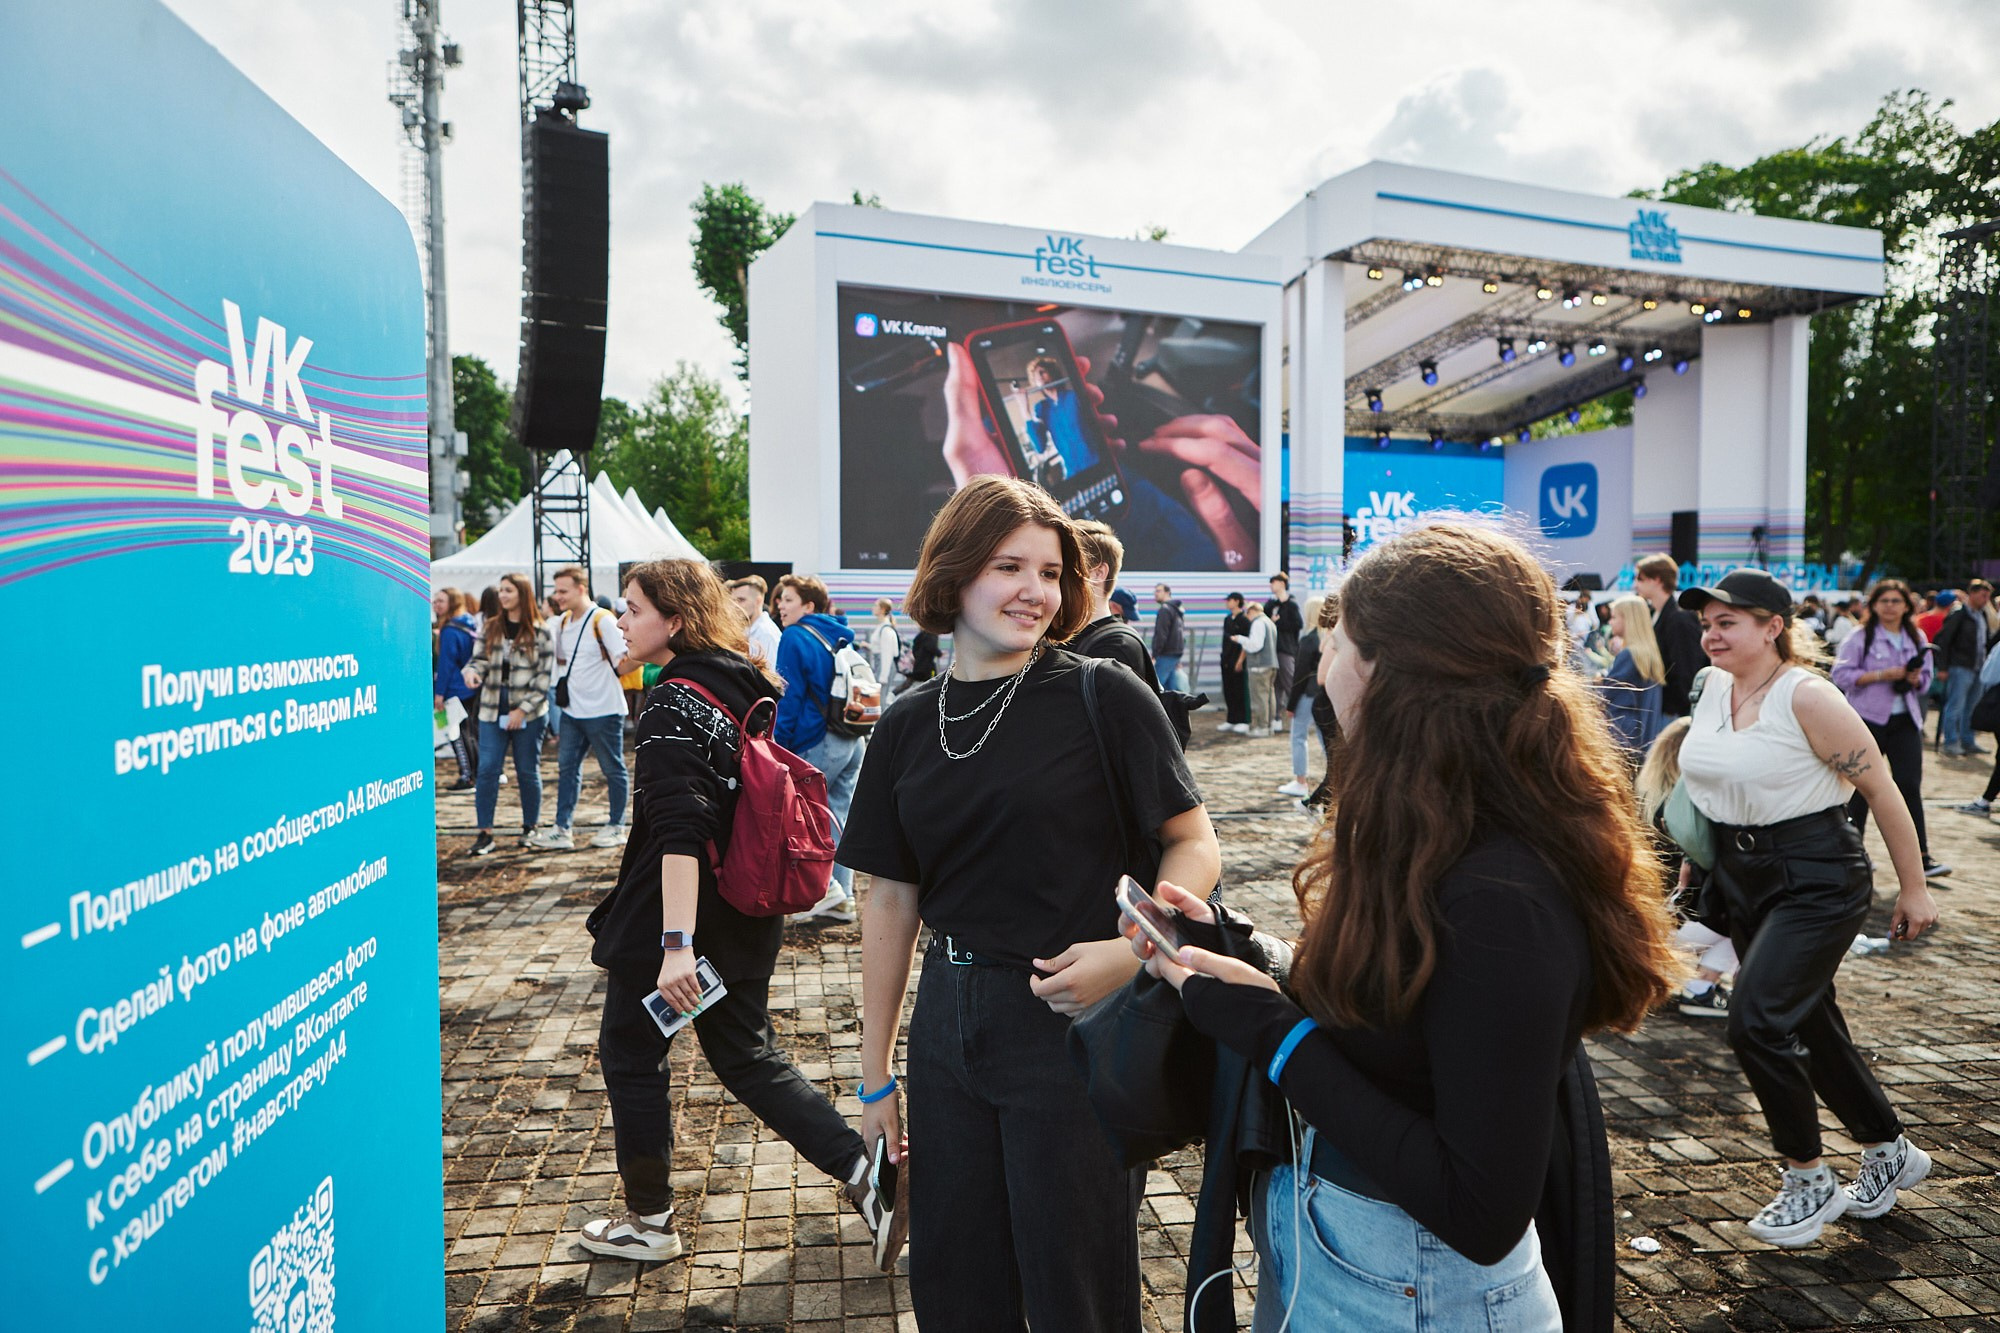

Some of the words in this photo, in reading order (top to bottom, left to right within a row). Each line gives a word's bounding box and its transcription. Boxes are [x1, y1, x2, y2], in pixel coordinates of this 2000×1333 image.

[1046, 235, 1085, 256] VK
[1637, 209, 1669, 230] VK
[1021, 276, 1112, 294] ИНФЛЮЕНСЕРЫ
[1035, 247, 1101, 278] fest
[881, 319, 902, 334] VK
[903, 321, 947, 338] Клипы
[222, 298, 315, 424] VK
[194, 358, 344, 520] fest
[1369, 491, 1416, 517] VK
[1549, 484, 1589, 518] VK
[229, 516, 314, 577] 2023
[1224, 550, 1243, 564] 12+
[142, 664, 233, 711] Получи
[238, 653, 359, 694] возможность
[115, 712, 267, 775] встретиться
[269, 709, 283, 736] с
[285, 696, 351, 734] Владом
[353, 685, 377, 718] А4!
[70, 855, 212, 940] Подпишись
[215, 841, 239, 875] на
[242, 802, 345, 863] сообщество
[347, 787, 365, 820] А4
[366, 769, 424, 811] ВКонтакте
[75, 964, 174, 1054] Сделай
[177, 942, 231, 1002] фото
[234, 928, 258, 962] на
[260, 901, 305, 953] фоне
[308, 855, 388, 920] автомобиля
[82, 1040, 220, 1169] Опубликуй
[223, 960, 344, 1068] получившееся
[345, 936, 377, 981] фото
[86, 1190, 105, 1230] к
[108, 1138, 172, 1210] себе
[176, 1113, 203, 1156] на
[206, 1038, 293, 1129] страницу
[295, 981, 368, 1057] ВКонтакте
[89, 1247, 108, 1285] с
[113, 1141, 228, 1267] хэштегом
[232, 1030, 347, 1158] #навстречуА4
